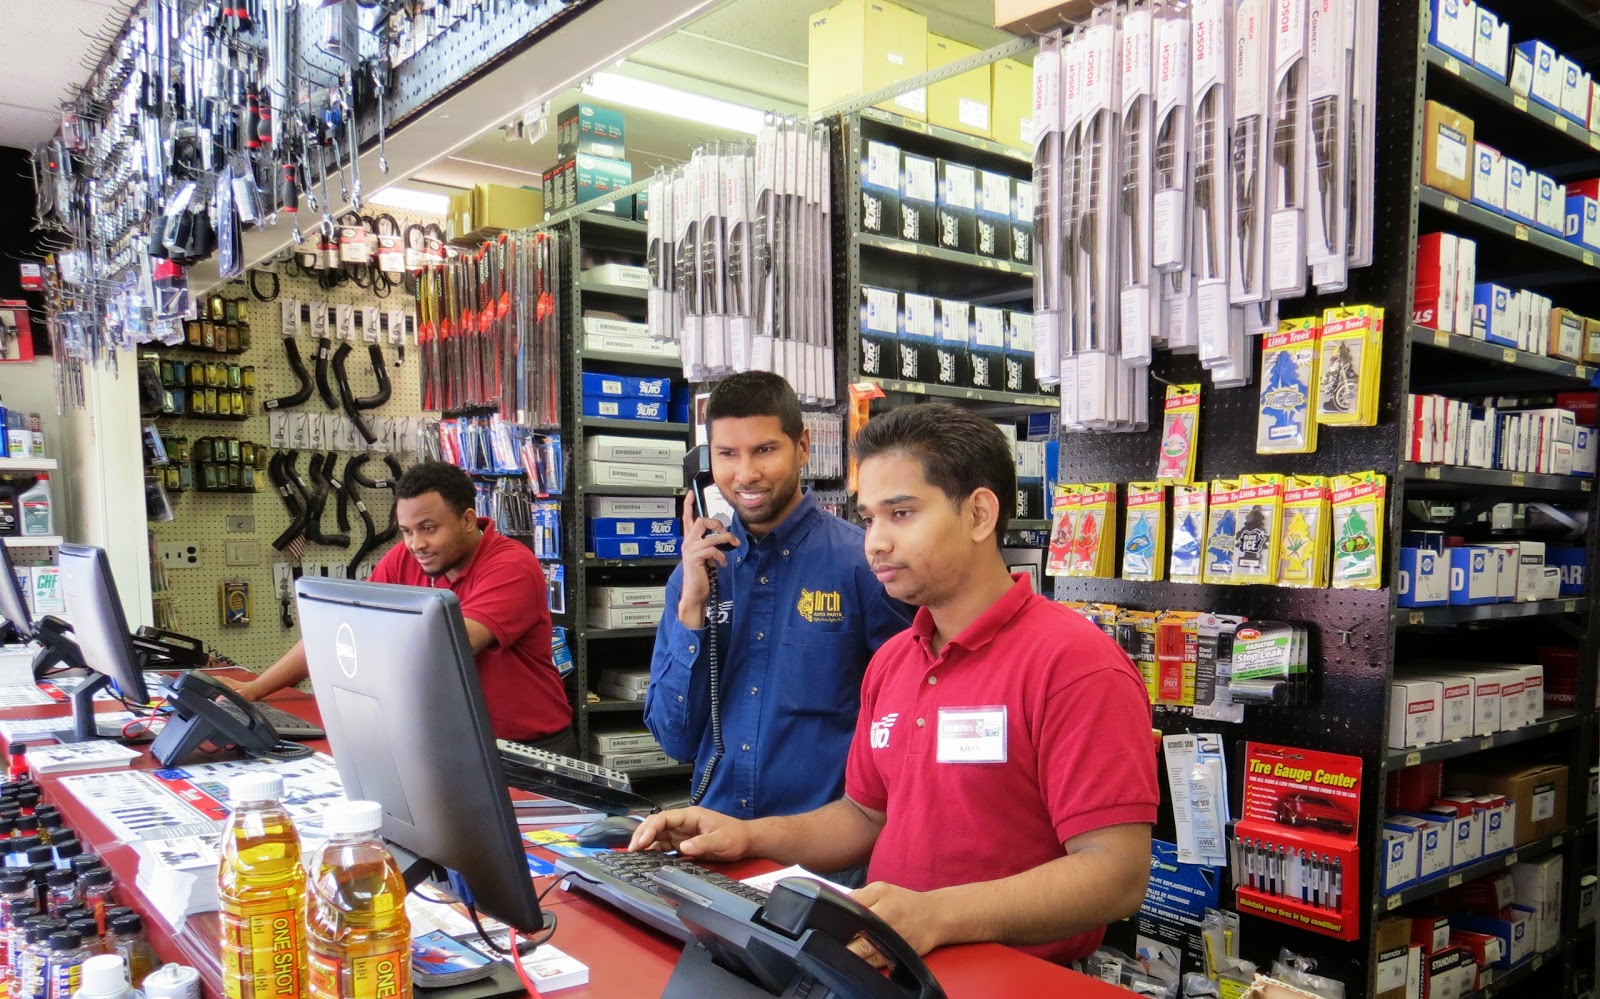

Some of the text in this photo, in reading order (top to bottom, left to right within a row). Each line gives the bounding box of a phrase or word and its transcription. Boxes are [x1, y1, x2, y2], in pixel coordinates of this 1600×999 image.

[1281, 0, 1290, 33] BOSC
[1323, 320, 1365, 334] Little Trees
[1268, 331, 1311, 348] Little Trees
[640, 385, 661, 394] AUTO
[1166, 397, 1198, 408] Little Trees
[637, 407, 658, 416] AUTO
[1082, 494, 1107, 504] Little Trees
[1128, 494, 1159, 504] Little Trees
[1212, 495, 1226, 503] Little
[1239, 488, 1274, 499] Little Trees
[1285, 493, 1301, 501] Little
[1334, 487, 1373, 502] Little Trees
[651, 525, 671, 533] AUTO
[655, 544, 675, 552] AUTO
[37, 574, 59, 589] CHF
[815, 590, 840, 611] Arch
[1245, 640, 1275, 650] RADIATOR
[1236, 647, 1283, 663] Stop Leak
[1163, 680, 1178, 688] EPOXY
[1446, 686, 1469, 697] STANDARD
[1477, 685, 1499, 695] STANDARD
[1409, 702, 1433, 712] STANDARD
[1249, 758, 1357, 788] Tire Gauge Center
[1288, 782, 1308, 790] PRESSURE
[1308, 785, 1320, 793] TIRES
[1162, 880, 1194, 893] REPLACEMENT
[1167, 894, 1190, 905] RECHARGE
[1157, 909, 1179, 920] REPUESTO
[1240, 898, 1342, 931] Maintain your tires in top condition!
[272, 917, 293, 995] ONE SHOT
[1431, 953, 1459, 970] STANDARD
[375, 960, 396, 999] ONE
